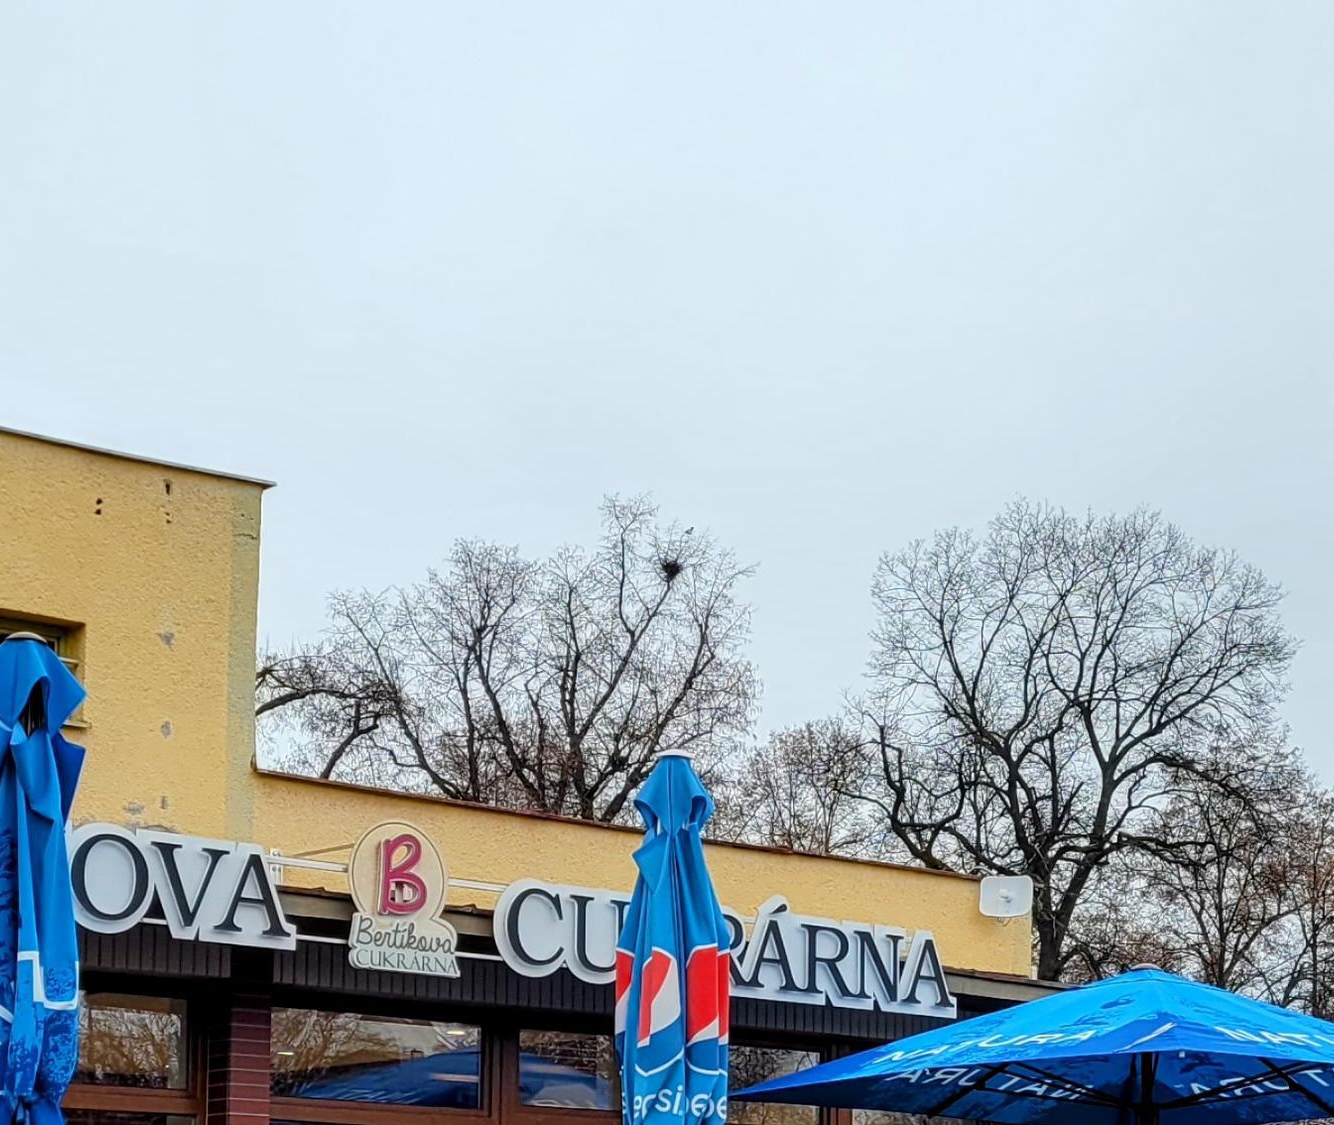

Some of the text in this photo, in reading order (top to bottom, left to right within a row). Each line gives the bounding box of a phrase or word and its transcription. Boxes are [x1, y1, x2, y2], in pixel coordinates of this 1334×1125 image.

[378, 834, 428, 916] B
[356, 915, 456, 955] Bertíkova
[356, 949, 459, 975] CUKRÁRNA
[507, 887, 956, 1009] CURÁRNA
